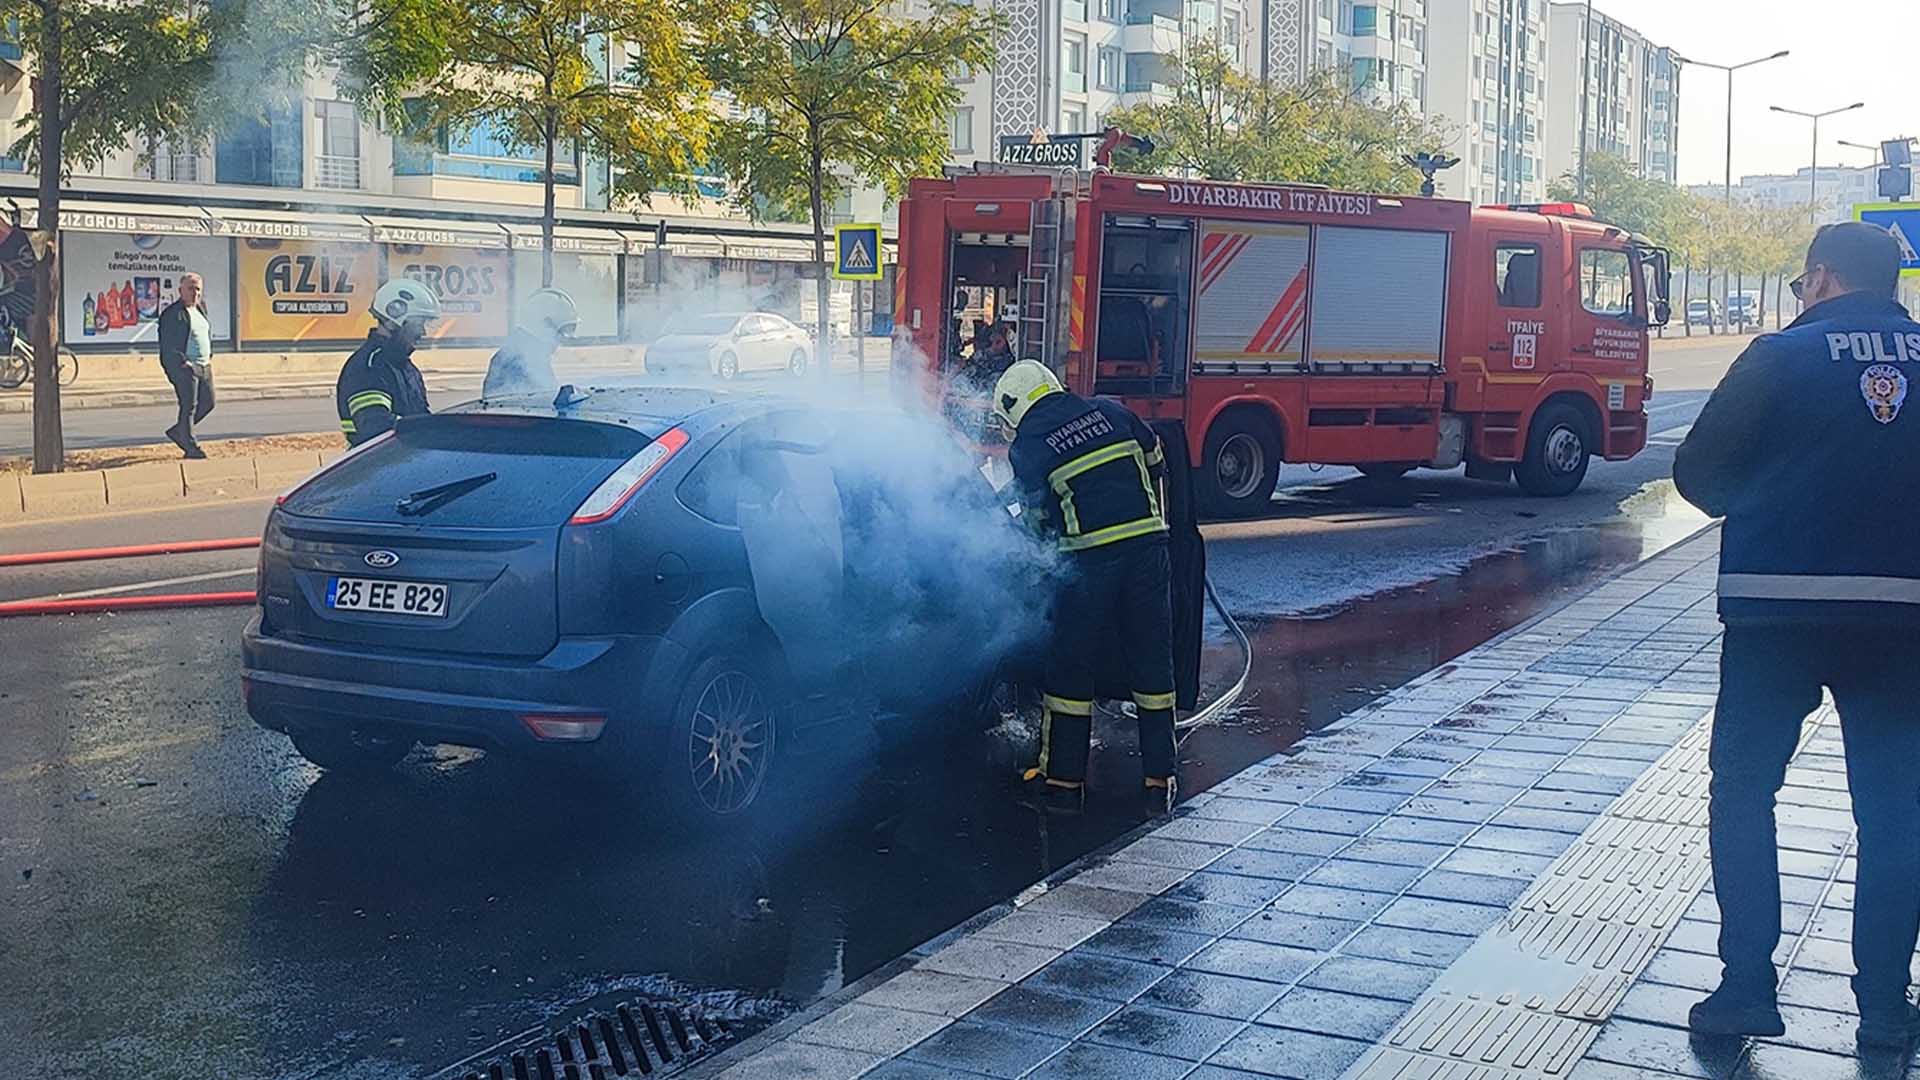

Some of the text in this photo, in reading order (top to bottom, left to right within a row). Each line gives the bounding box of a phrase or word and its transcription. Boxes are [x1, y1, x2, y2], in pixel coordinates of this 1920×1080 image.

[1034, 143, 1078, 162] GROSS
[84, 214, 136, 230] GROSS
[264, 223, 309, 237] GROSS
[417, 231, 456, 243] GROSS
[1517, 339, 1533, 354] 112
[336, 581, 444, 613] 25 EE 829
